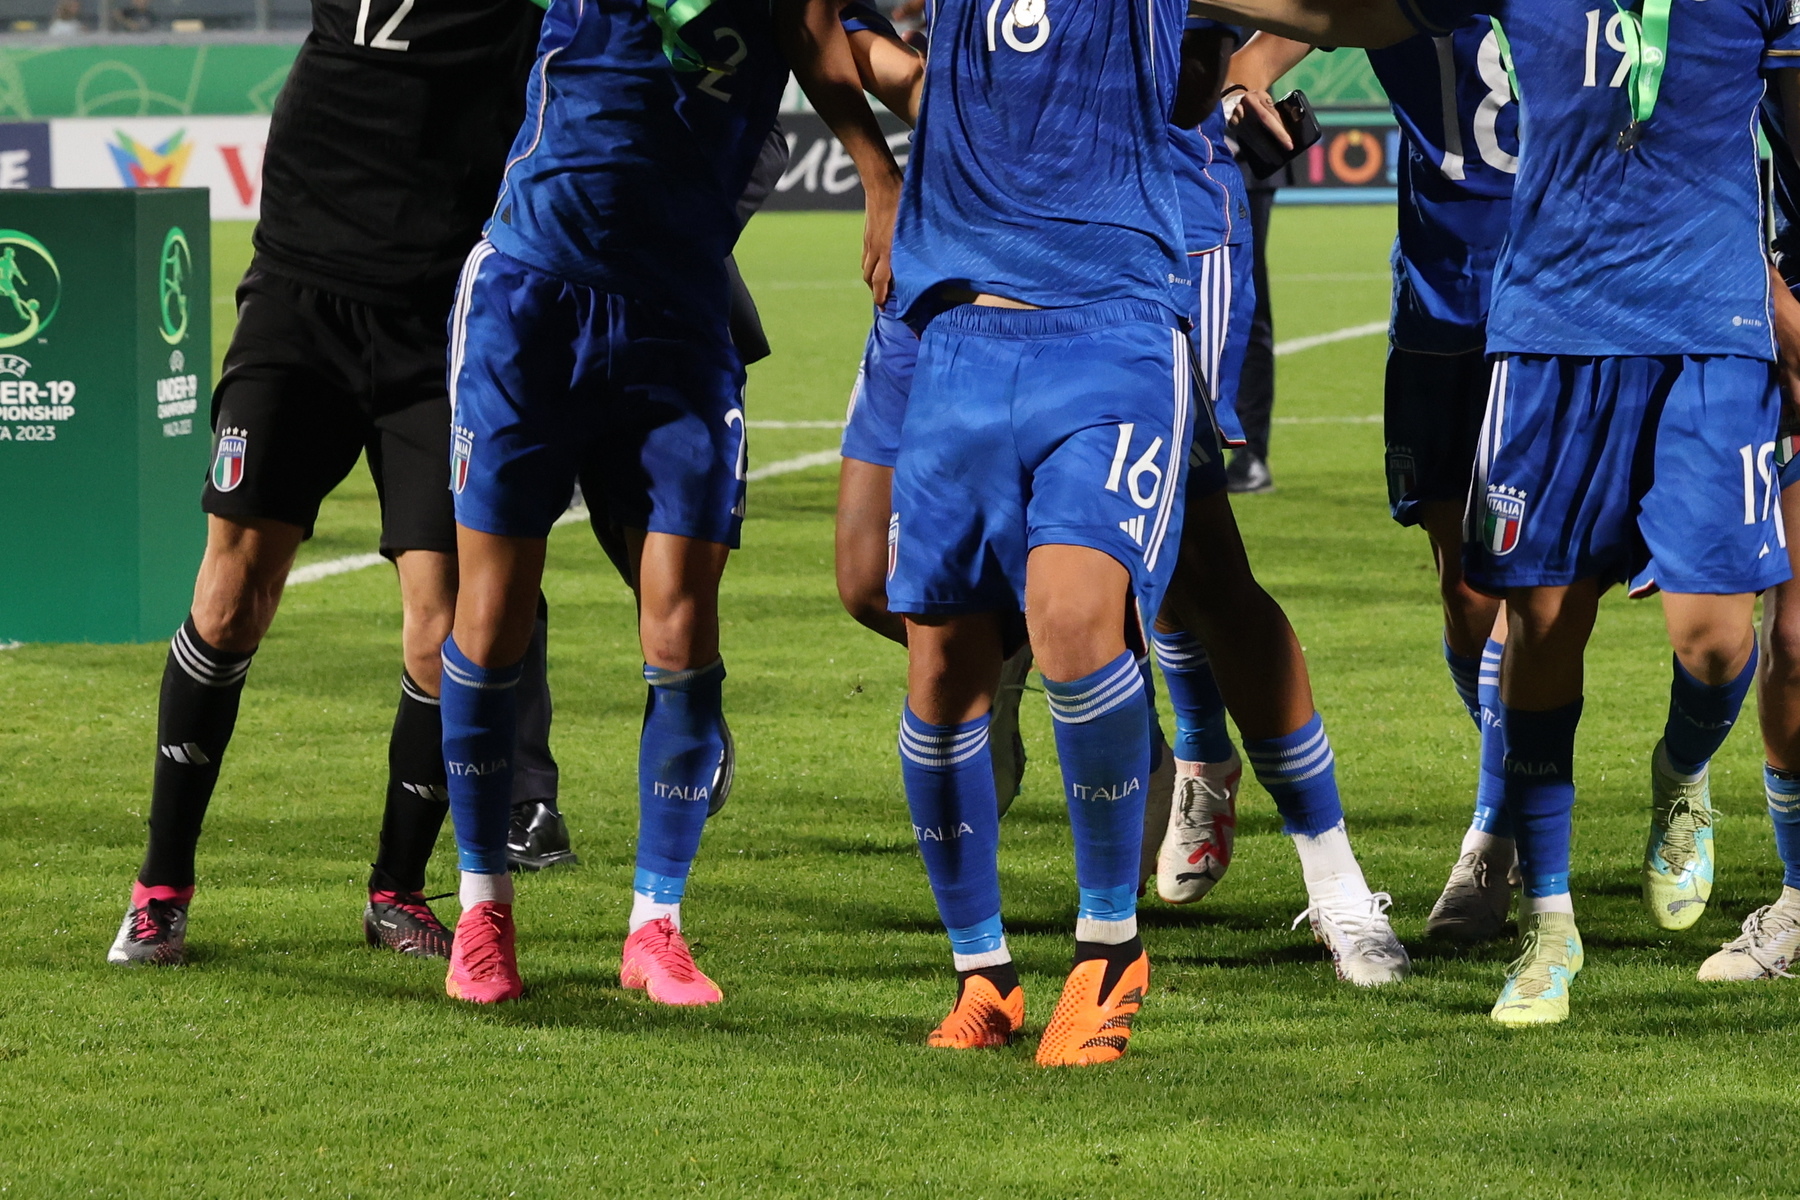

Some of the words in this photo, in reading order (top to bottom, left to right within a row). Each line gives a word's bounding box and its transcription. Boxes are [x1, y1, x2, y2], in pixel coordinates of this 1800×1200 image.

[1582, 9, 1641, 88] 19
[697, 26, 747, 103] 2
[1432, 29, 1519, 181] 18
[15, 425, 57, 441] 2023
[1104, 422, 1164, 510] 16
[1489, 497, 1519, 516] ITALIA
[448, 759, 508, 776] ITALIA
[653, 781, 708, 801] ITALIA
[1072, 776, 1140, 802] ITALIA
